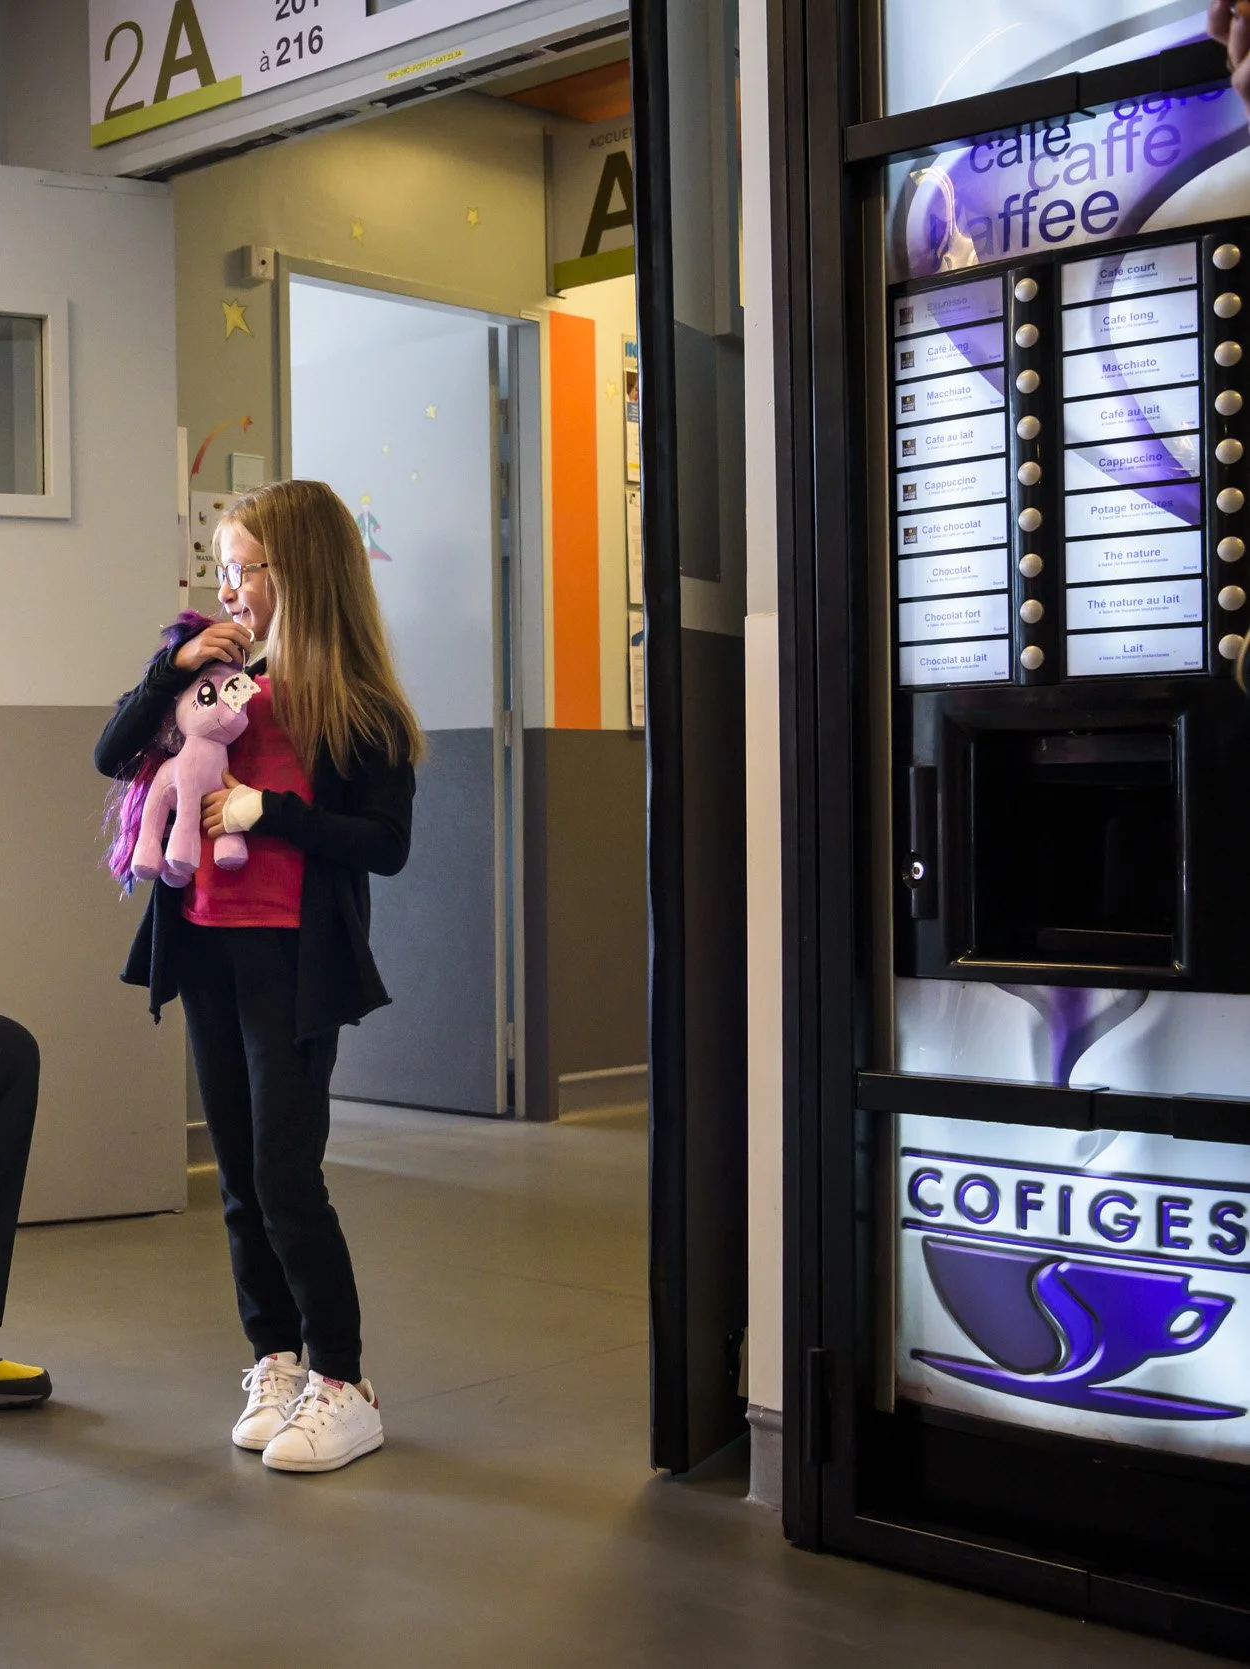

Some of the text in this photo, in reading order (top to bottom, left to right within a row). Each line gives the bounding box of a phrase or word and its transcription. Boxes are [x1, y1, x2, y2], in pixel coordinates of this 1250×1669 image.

[275, 0, 319, 21] 20
[259, 25, 323, 72] à 216
[1127, 262, 1155, 275] court
[1130, 311, 1154, 323] long
[927, 341, 969, 356] Café long
[1102, 358, 1157, 373] Macchiato
[926, 386, 971, 401] Macchiato
[1100, 404, 1160, 420] Café au lait
[925, 430, 974, 445] Café au lait
[1098, 453, 1163, 468] Cappuccino
[924, 476, 977, 491] Cappuccino
[1090, 504, 1127, 516] Potage
[1130, 500, 1174, 512] tomates
[922, 525, 941, 535] Café
[943, 520, 981, 532] chocolat
[1103, 548, 1161, 561] Thé nature
[932, 565, 971, 577] Chocolat
[1087, 594, 1180, 610] Thé nature au lait
[924, 609, 981, 622] Chocolat fort
[1123, 644, 1143, 653] Lait
[919, 653, 988, 667] Chocolat au lait
[907, 1167, 1248, 1256] COFIGES
